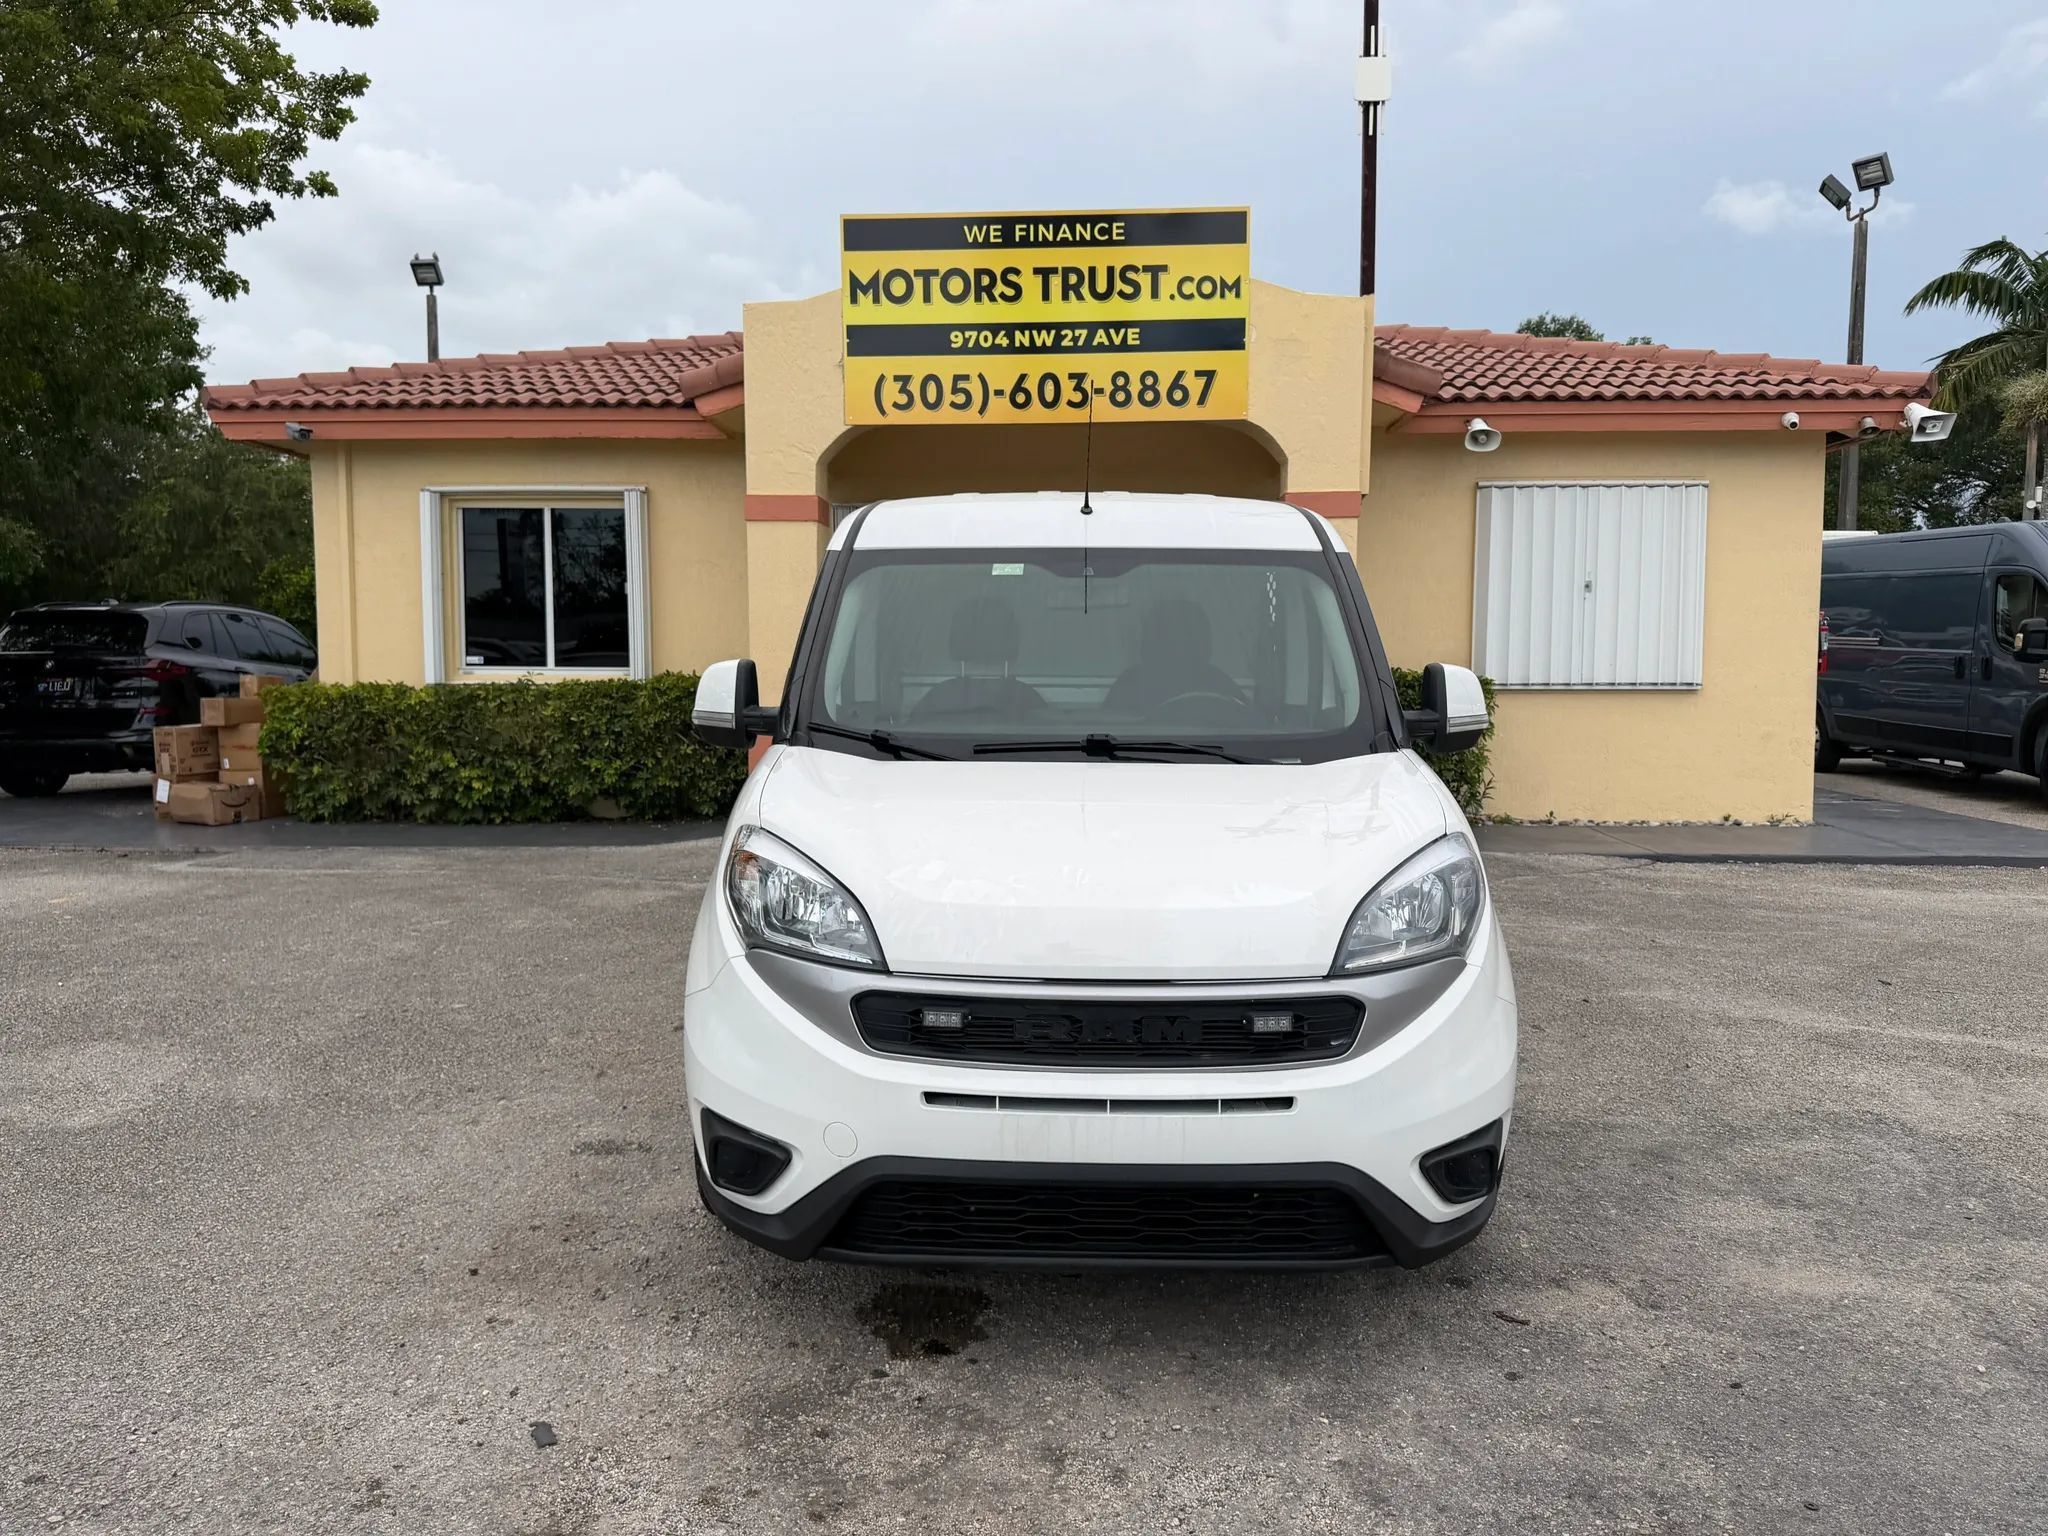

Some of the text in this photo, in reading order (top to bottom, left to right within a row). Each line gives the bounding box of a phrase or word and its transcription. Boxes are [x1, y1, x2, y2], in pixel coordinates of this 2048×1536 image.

[963, 221, 1126, 243] WE FINANCE
[848, 266, 1024, 306] MOTORS
[949, 327, 1141, 349] 9704 NW 27 AVE
[873, 368, 1218, 418] (305)-603-8867
